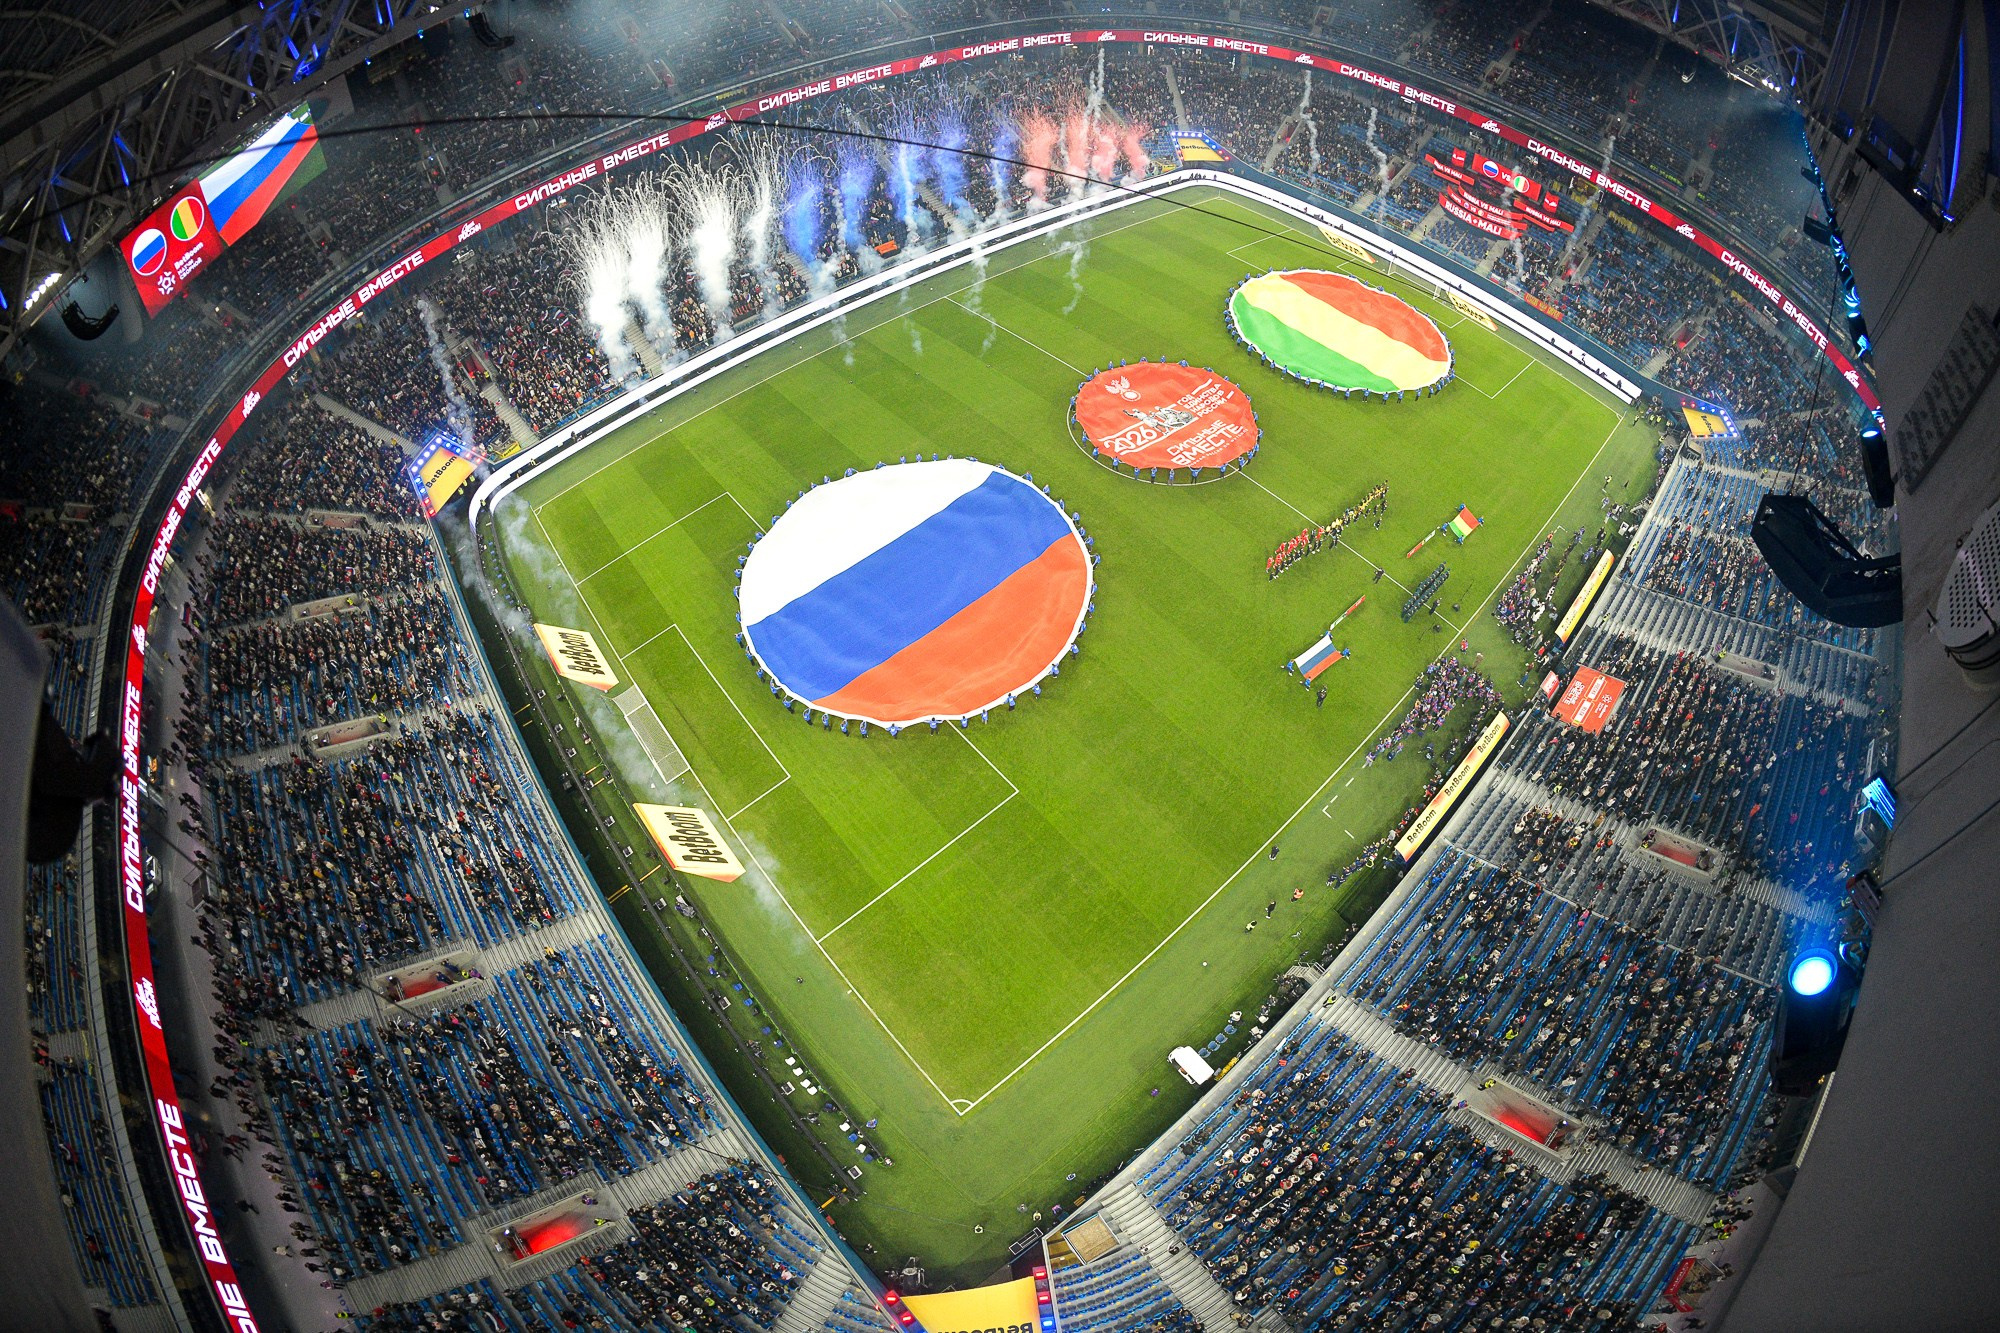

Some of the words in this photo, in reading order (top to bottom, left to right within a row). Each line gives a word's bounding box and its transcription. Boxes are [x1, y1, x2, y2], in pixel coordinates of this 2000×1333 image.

[963, 39, 1018, 58] СИЛЬНЫЕ
[1023, 32, 1072, 48] ВМЕСТЕ
[1143, 32, 1208, 46] СИЛЬНЫЕ
[1214, 37, 1268, 54] ВМЕСТЕ
[758, 80, 830, 112] СИЛЬНЫЕ
[836, 64, 892, 90] ВМЕСТЕ
[1340, 64, 1400, 92] СИЛЬНЫЕ
[1405, 86, 1456, 114] ВМЕСТЕ
[515, 162, 598, 211] СИЛЬНЫЕ
[602, 132, 671, 171] ВМЕСТЕ
[1501, 172, 1511, 182] VS
[1527, 139, 1592, 179] СИЛЬНЫЕ
[1596, 174, 1652, 212] ВМЕСТЕ
[1445, 201, 1472, 224] RUSSIA
[1477, 219, 1502, 236] MALI
[1488, 205, 1504, 217] MALI
[174, 242, 204, 270] BetBoom
[283, 299, 357, 369] СИЛЬНЫЕ
[357, 251, 425, 304] ВМЕСТЕ
[1720, 250, 1782, 304] СИЛЬНЫЕ
[1782, 300, 1829, 350] ВМЕСТЕ
[1177, 394, 1194, 406] ГОД
[1184, 383, 1222, 409] ЕДИНСТВА
[1190, 390, 1224, 414] НАРОДОВ
[1198, 398, 1227, 418] РОССИИ
[1103, 426, 1158, 453] 2026
[1166, 419, 1227, 456] СИЛЬНЫЕ
[1170, 423, 1244, 467] ВМЕСТЕ
[425, 456, 457, 488] BetBoom
[143, 505, 182, 595] СИЛЬНЫЕ
[177, 437, 222, 510] ВМЕСТЕ
[558, 632, 605, 675] BetBoom
[123, 680, 140, 776] ВМЕСТЕ
[1477, 723, 1501, 753] BetBoom
[1444, 764, 1471, 797] BetBoom
[122, 775, 143, 913] СИЛЬНЫЕ
[664, 811, 729, 864] BetBoom
[1406, 809, 1437, 844] BetBoom
[158, 1098, 228, 1265] ВМЕСТЕ
